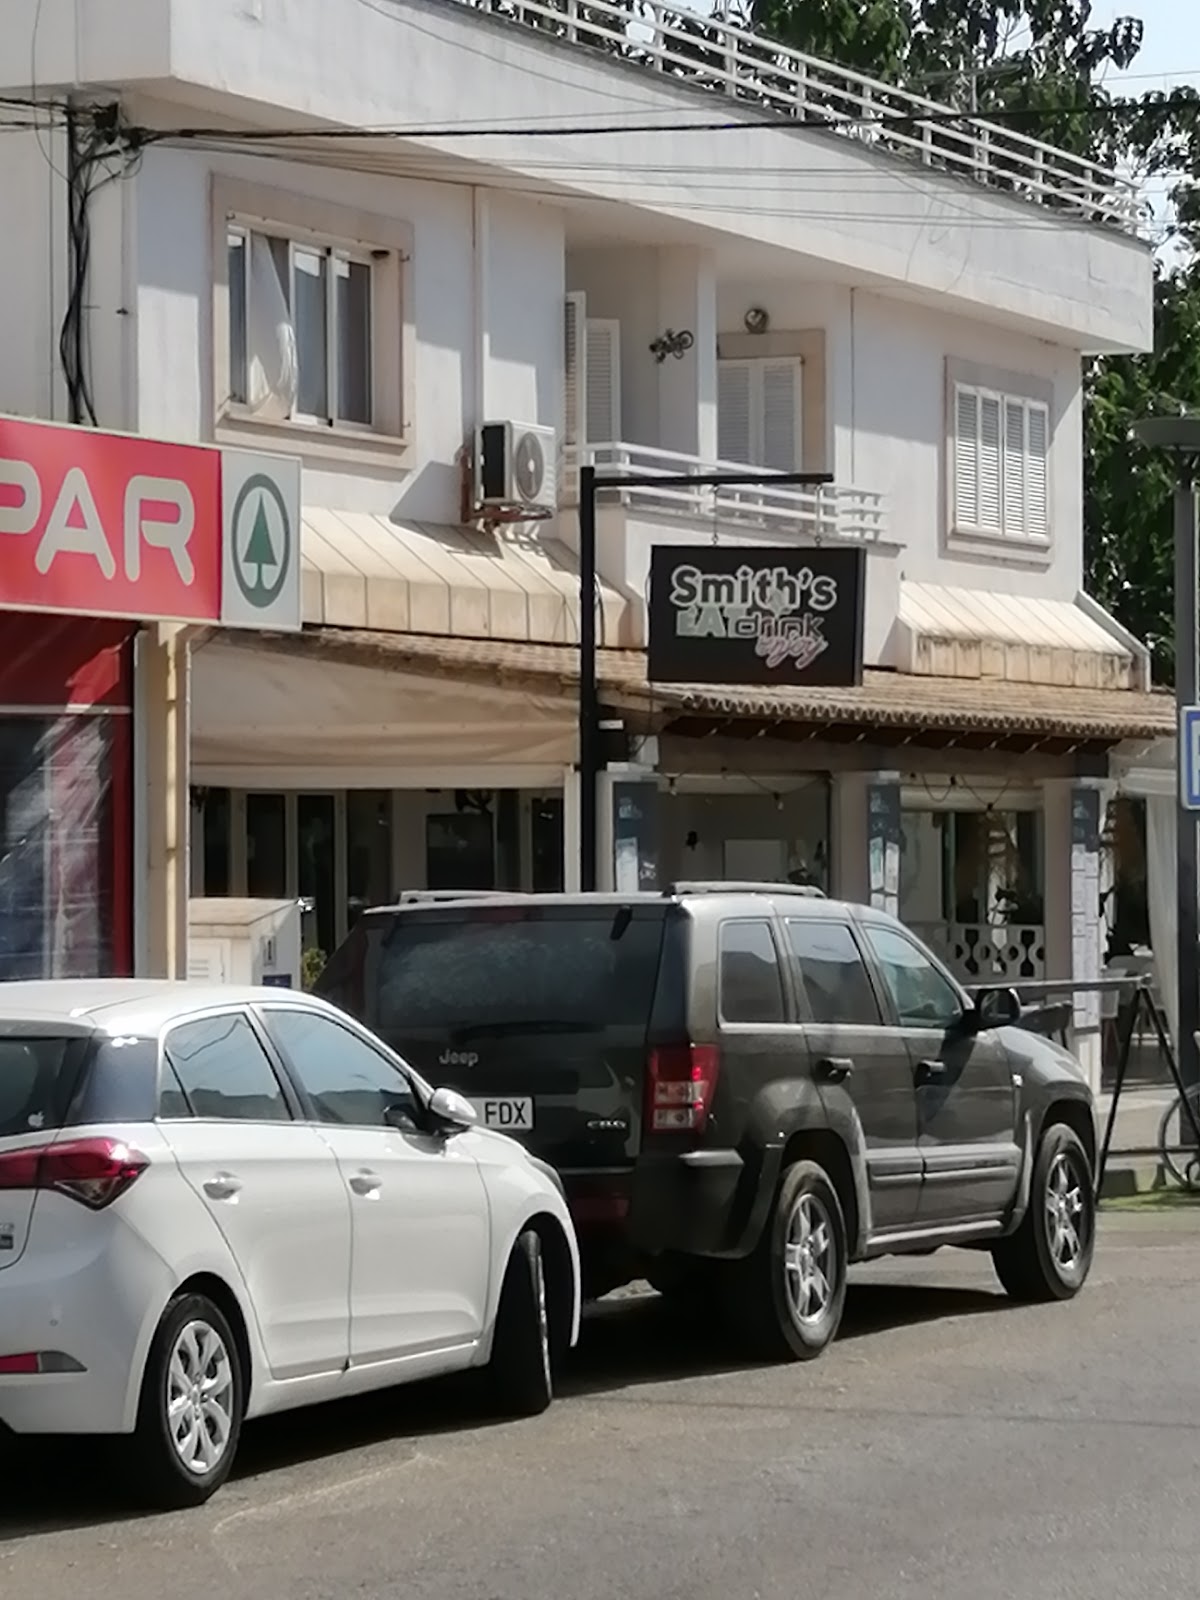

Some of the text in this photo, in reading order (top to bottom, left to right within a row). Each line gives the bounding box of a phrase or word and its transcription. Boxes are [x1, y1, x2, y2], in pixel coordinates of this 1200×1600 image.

[670, 565, 837, 610] Smith's
[439, 1049, 478, 1067] Jeep
[485, 1102, 526, 1124] FDX
